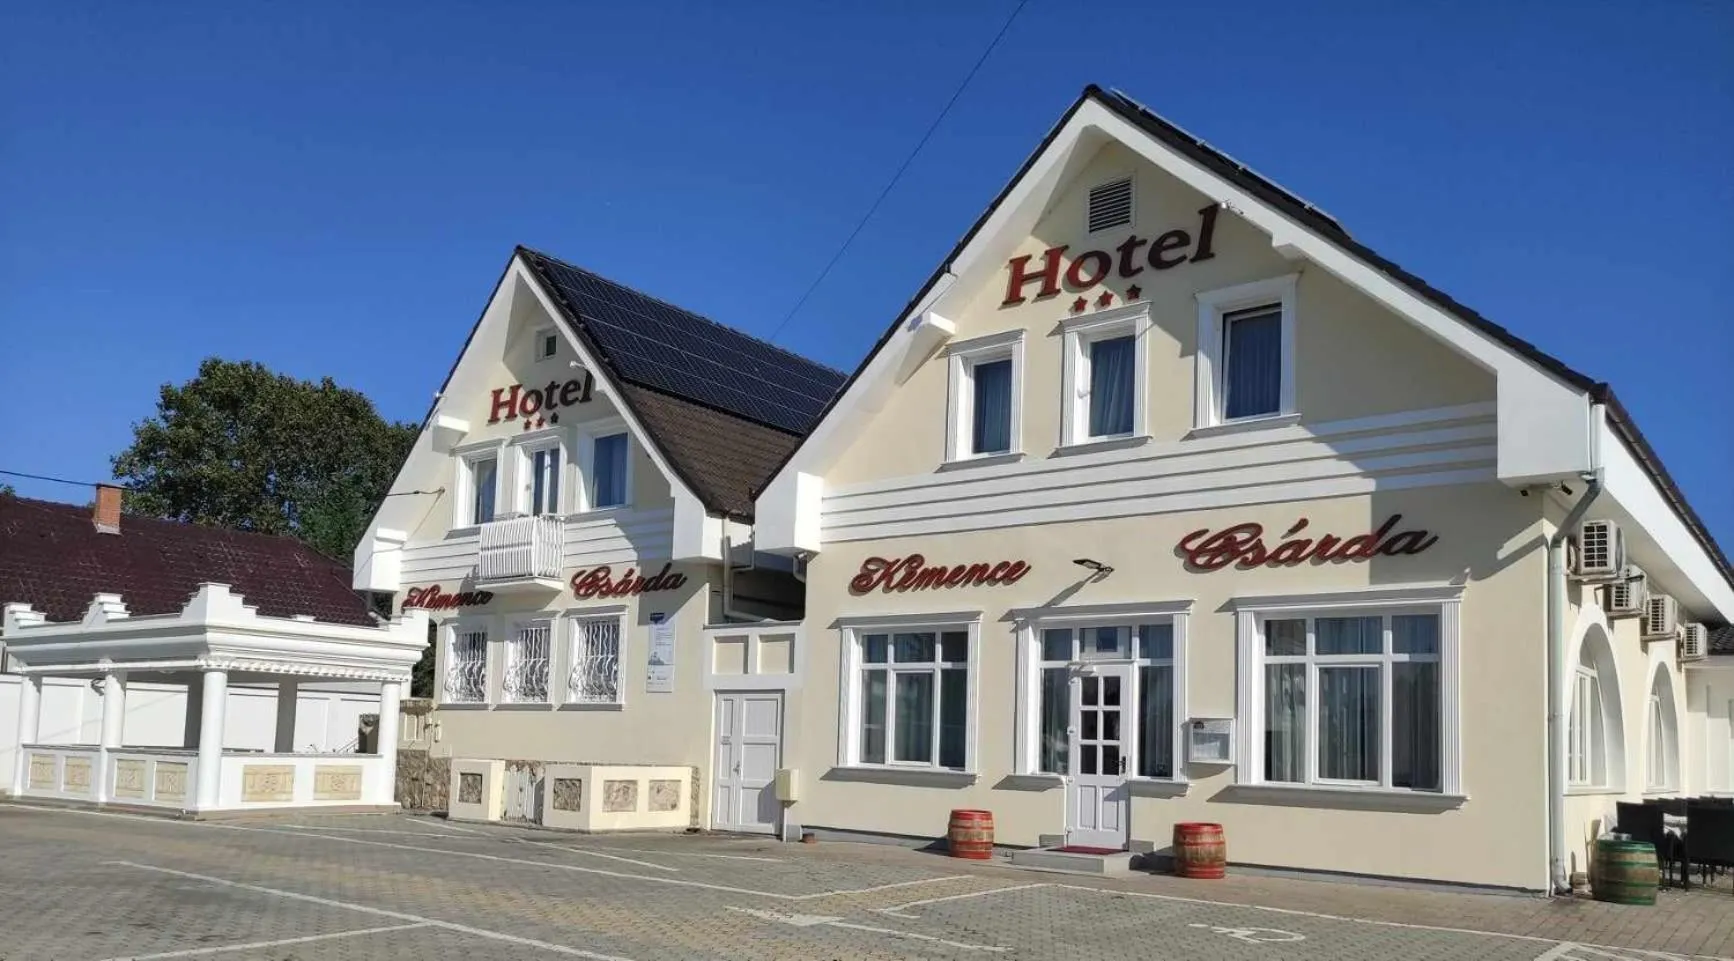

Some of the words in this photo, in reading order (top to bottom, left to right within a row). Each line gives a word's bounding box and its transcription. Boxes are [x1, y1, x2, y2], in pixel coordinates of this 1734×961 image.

[1001, 203, 1219, 305] Hotel
[488, 368, 593, 423] Hotel
[571, 562, 688, 598] Csárda
[850, 554, 1032, 593] Kemence
[1179, 514, 1438, 569] Csárda
